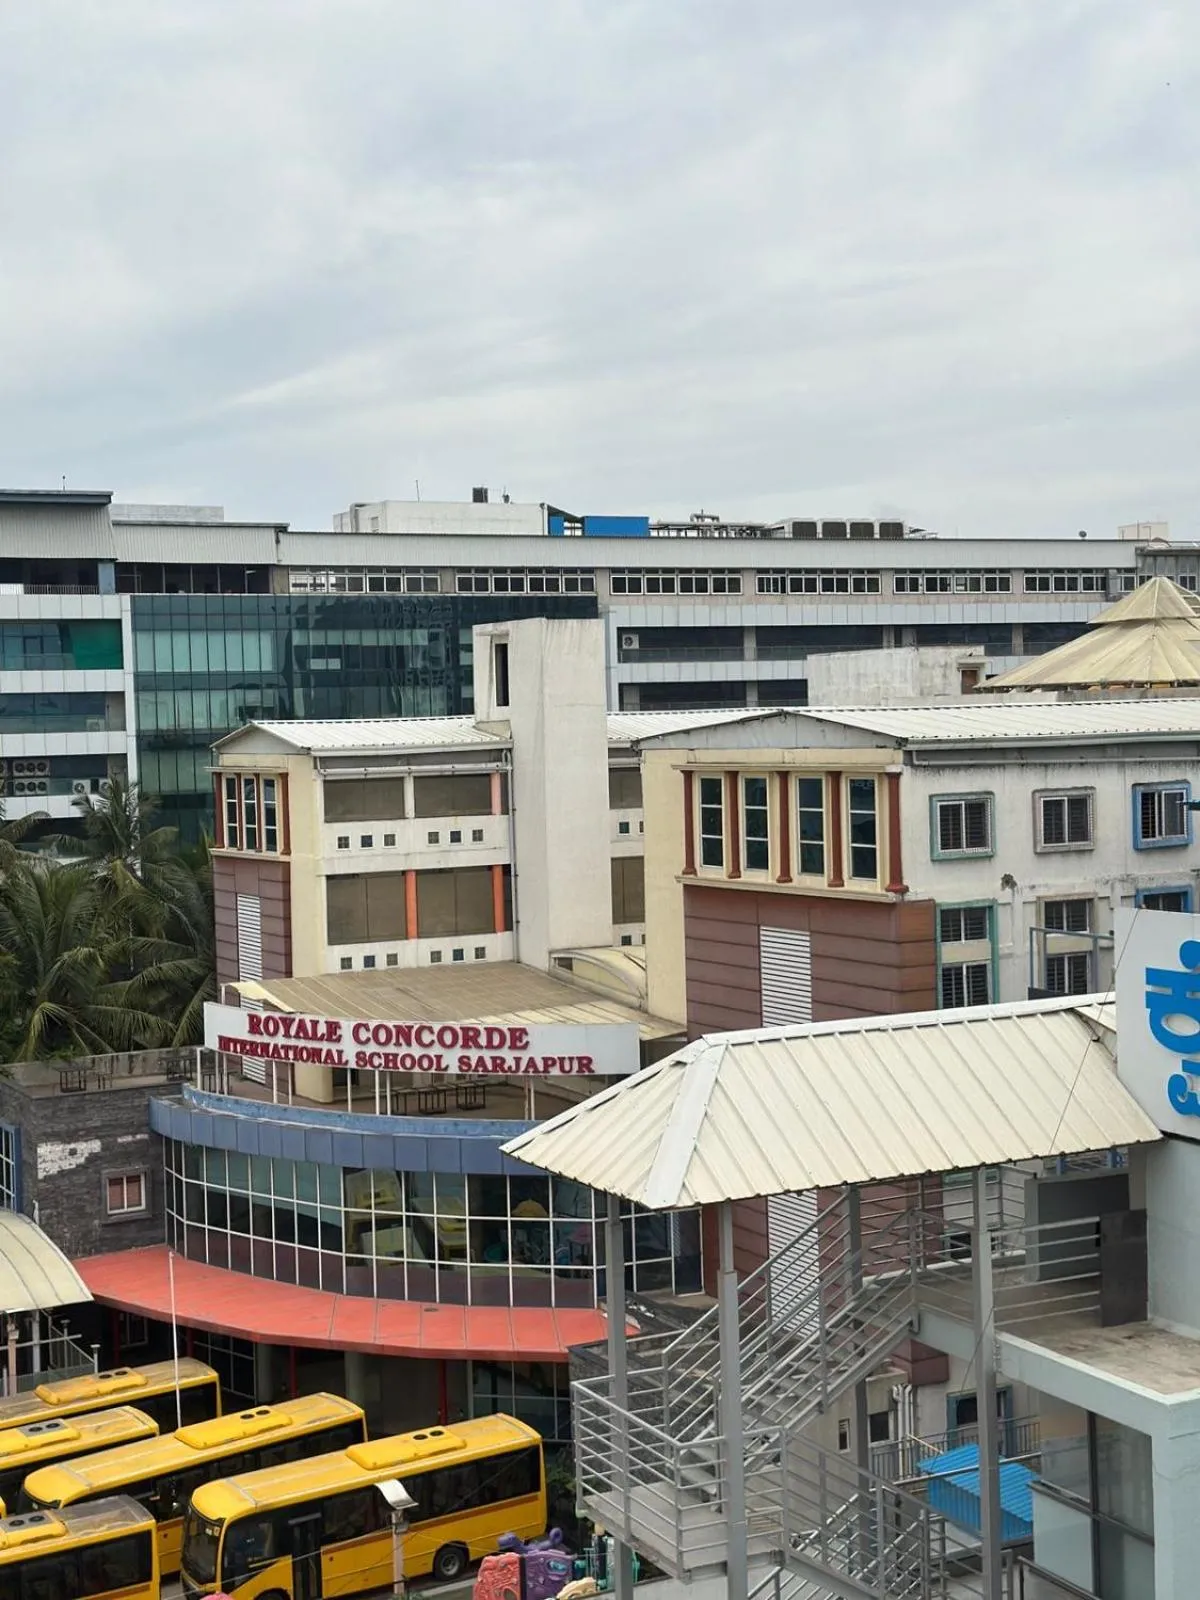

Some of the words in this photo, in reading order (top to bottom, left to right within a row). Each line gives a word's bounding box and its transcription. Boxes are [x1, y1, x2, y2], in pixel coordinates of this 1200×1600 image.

[247, 1013, 342, 1043] ROYALE
[352, 1022, 530, 1050] CONCORDE
[218, 1035, 349, 1066] INTERNATIONAL
[355, 1051, 449, 1072] SCHOOL
[458, 1055, 596, 1074] SARJAPUR
